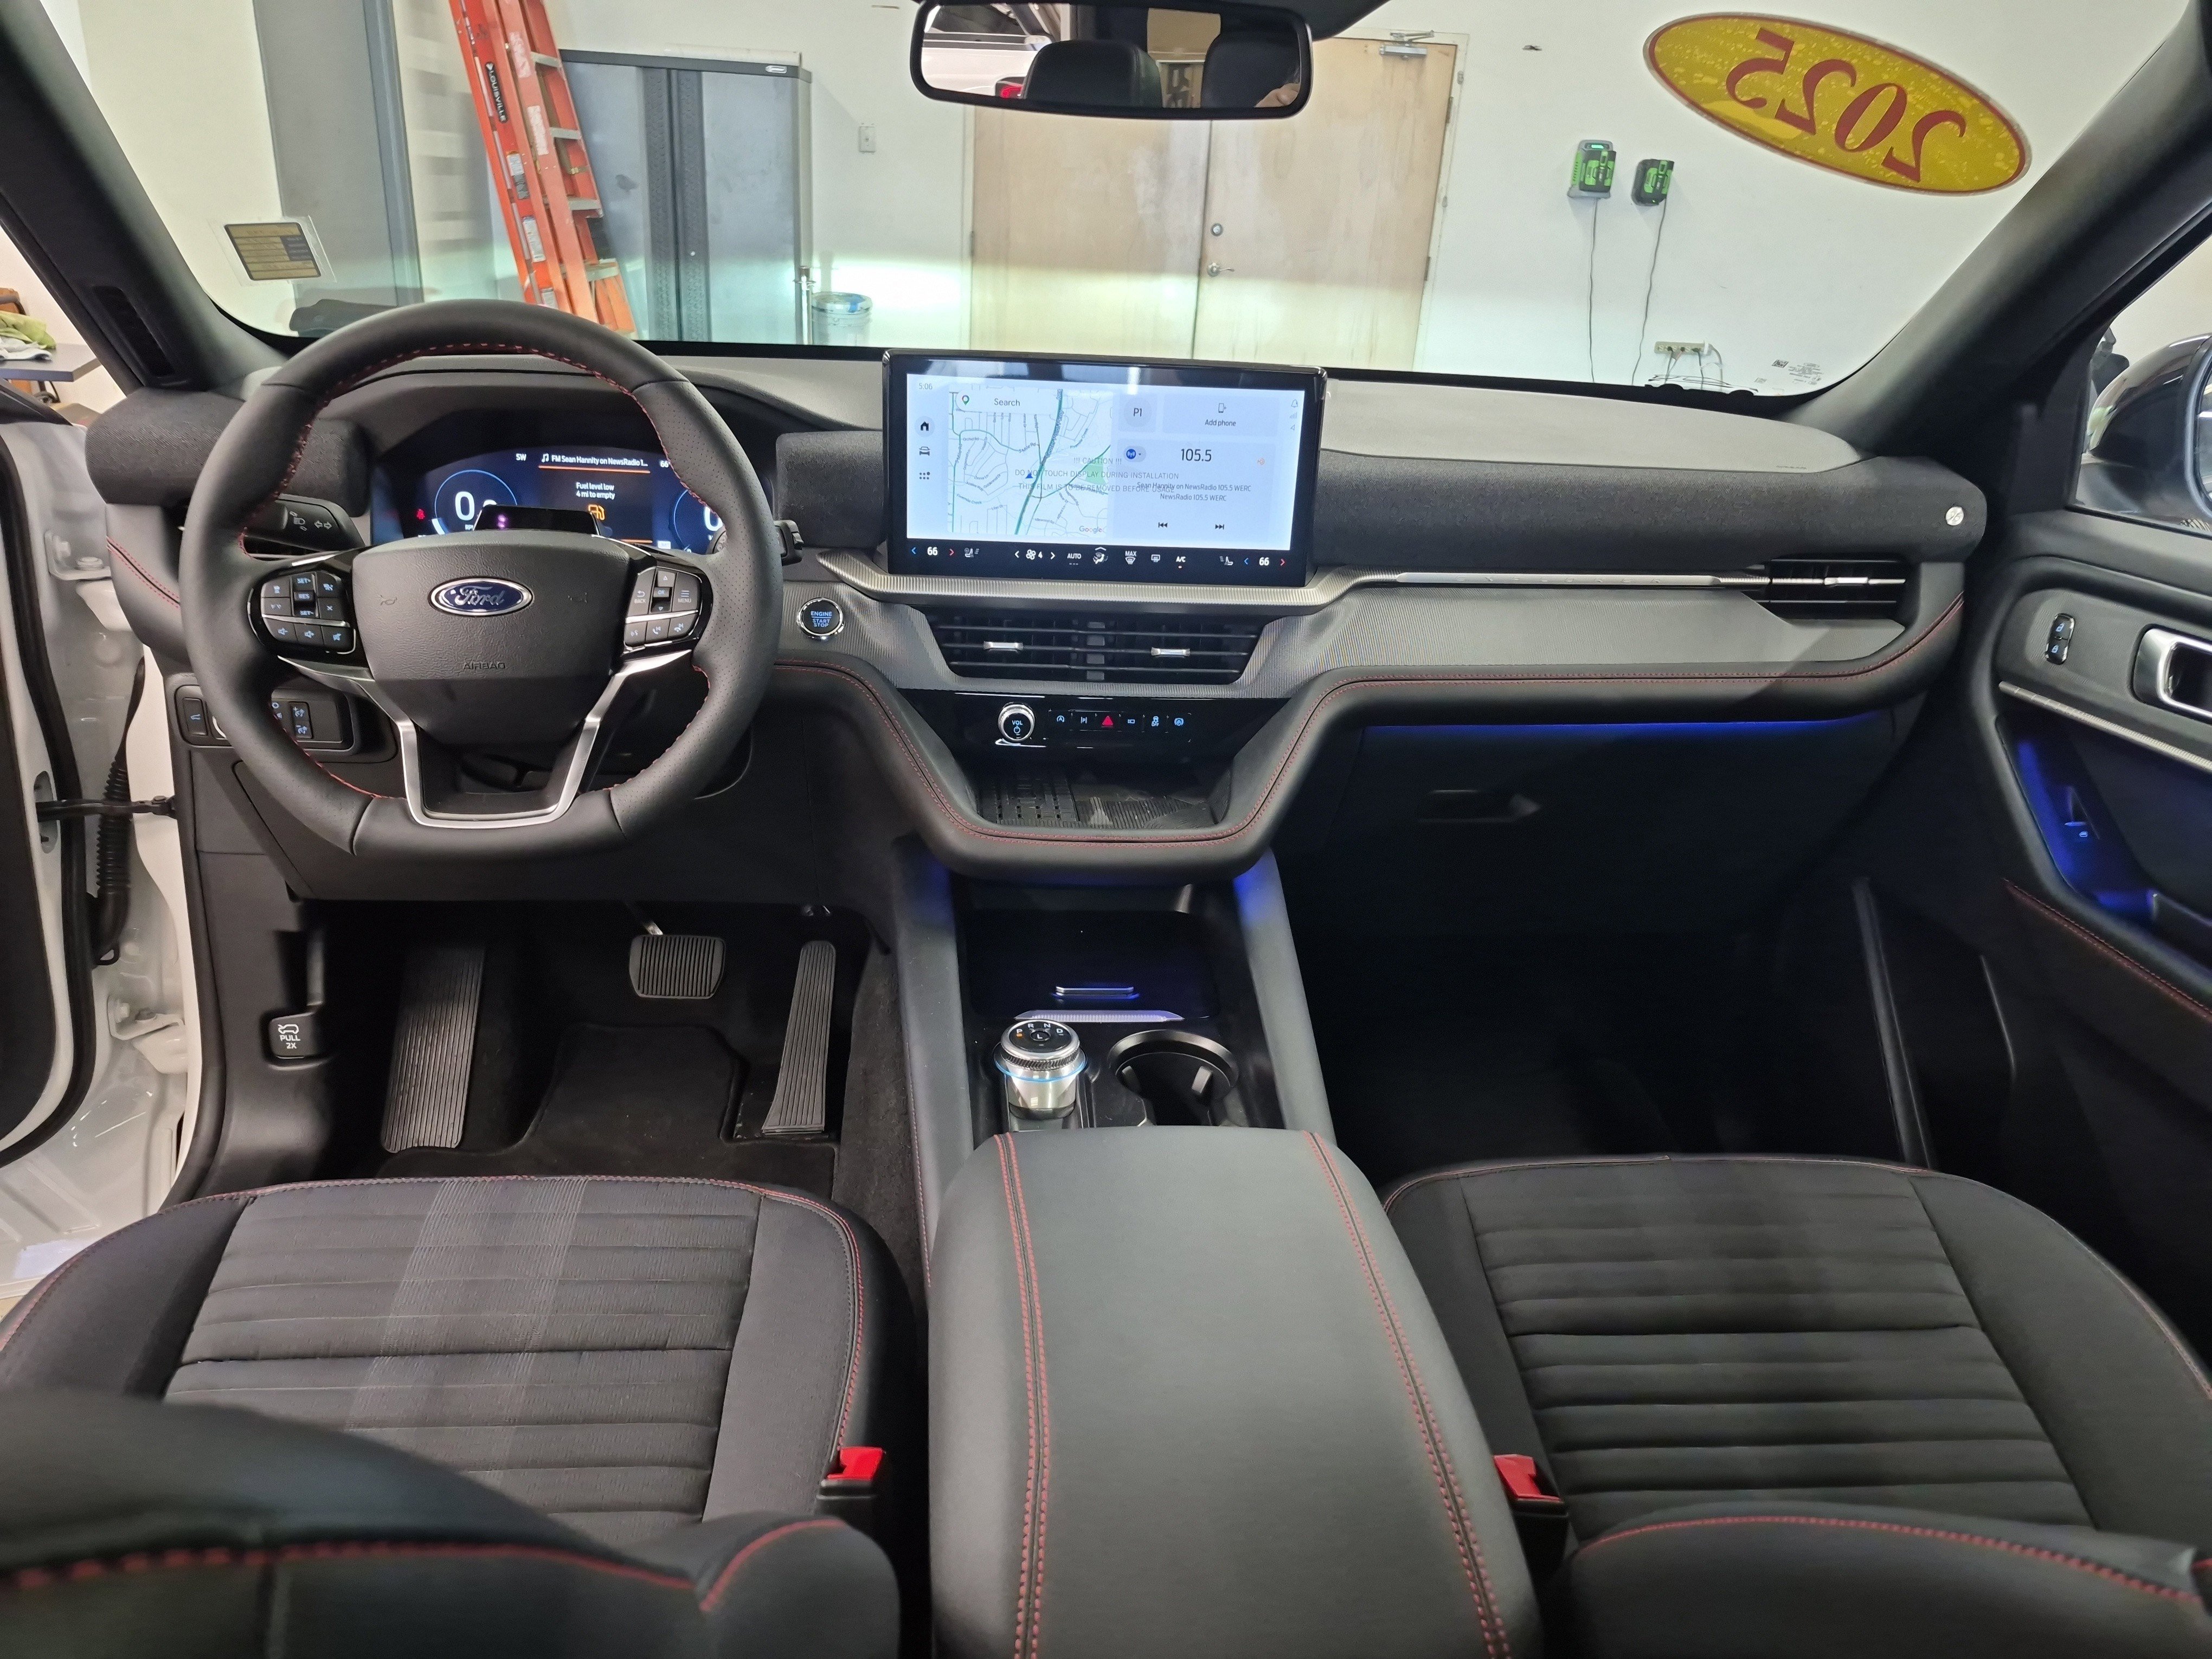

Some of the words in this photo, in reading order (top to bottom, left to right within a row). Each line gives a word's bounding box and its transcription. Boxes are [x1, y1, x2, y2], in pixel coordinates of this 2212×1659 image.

[489, 70, 507, 122] LOUISVILLE
[994, 398, 1020, 407] Search
[1133, 408, 1142, 417] P1
[516, 453, 527, 461] SW
[1181, 448, 1212, 462] 105.5
[576, 456, 600, 465] Hannity
[608, 458, 640, 466] NewsRadio
[596, 492, 615, 500] empty
[1079, 525, 1102, 534] Google
[927, 546, 938, 556] 66
[1258, 557, 1270, 566] 66
[454, 586, 505, 606] Ford
